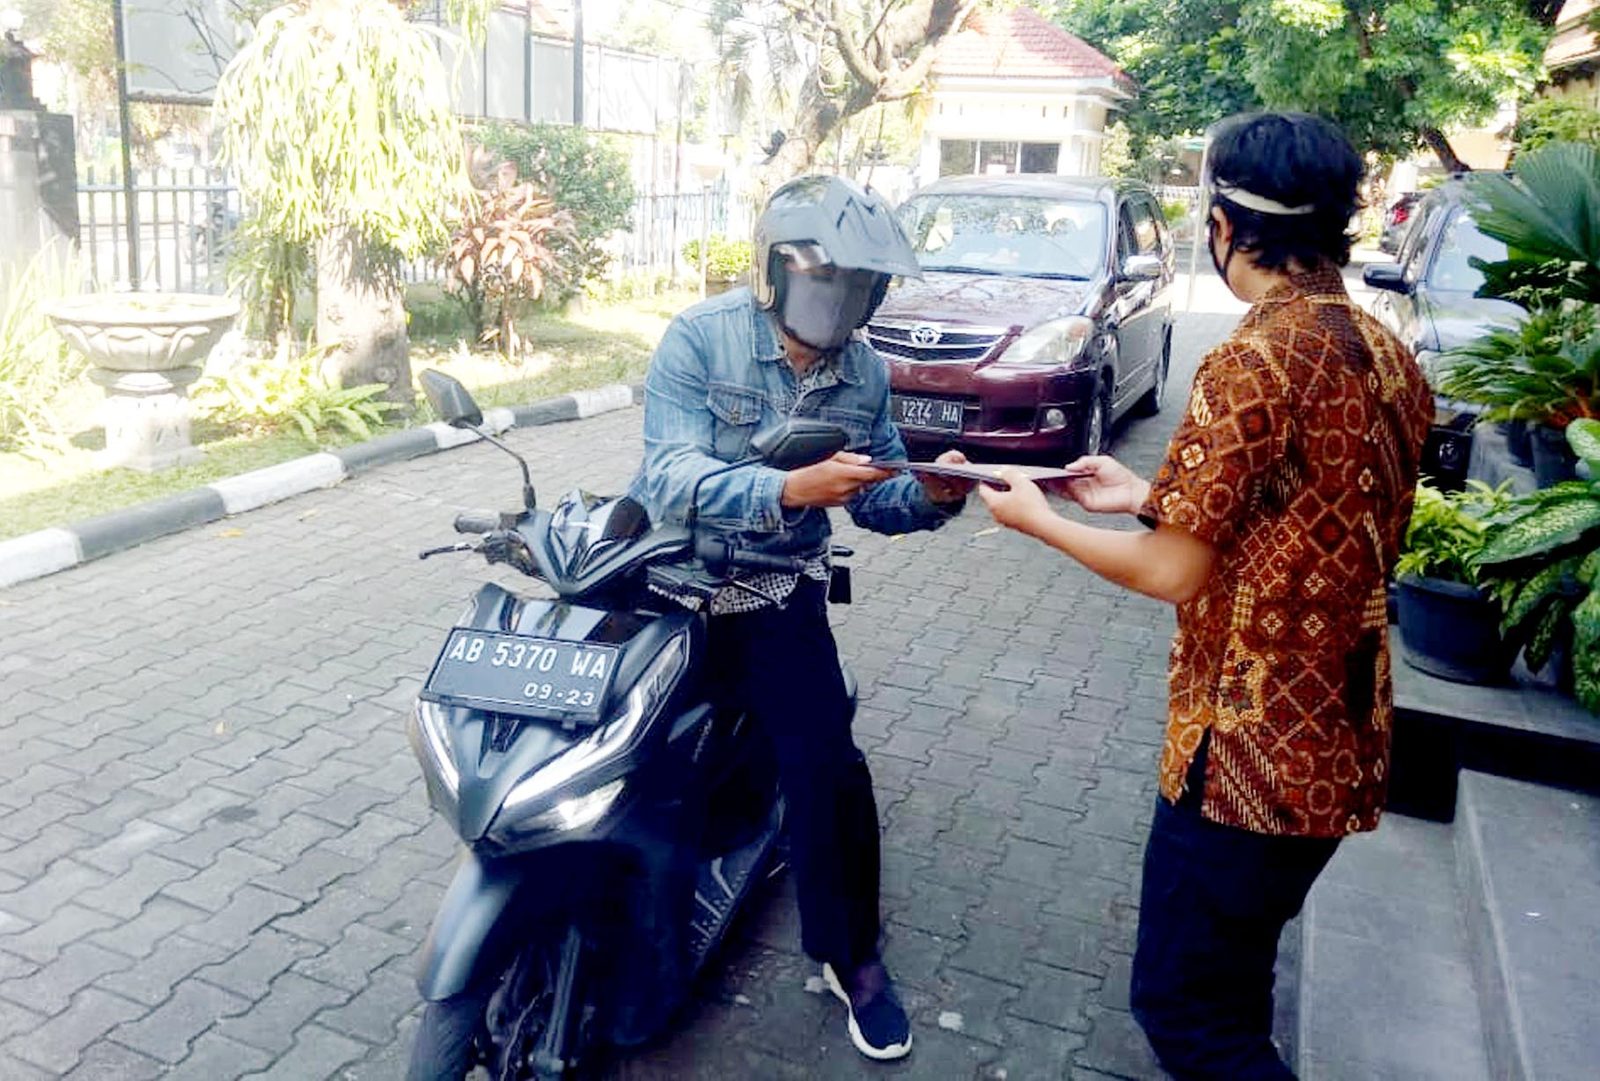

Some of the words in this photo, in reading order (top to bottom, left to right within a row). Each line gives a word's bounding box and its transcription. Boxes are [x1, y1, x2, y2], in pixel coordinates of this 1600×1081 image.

[941, 403, 958, 422] HA
[449, 637, 485, 662] AB
[491, 641, 558, 672] 5370
[570, 651, 607, 679] WA
